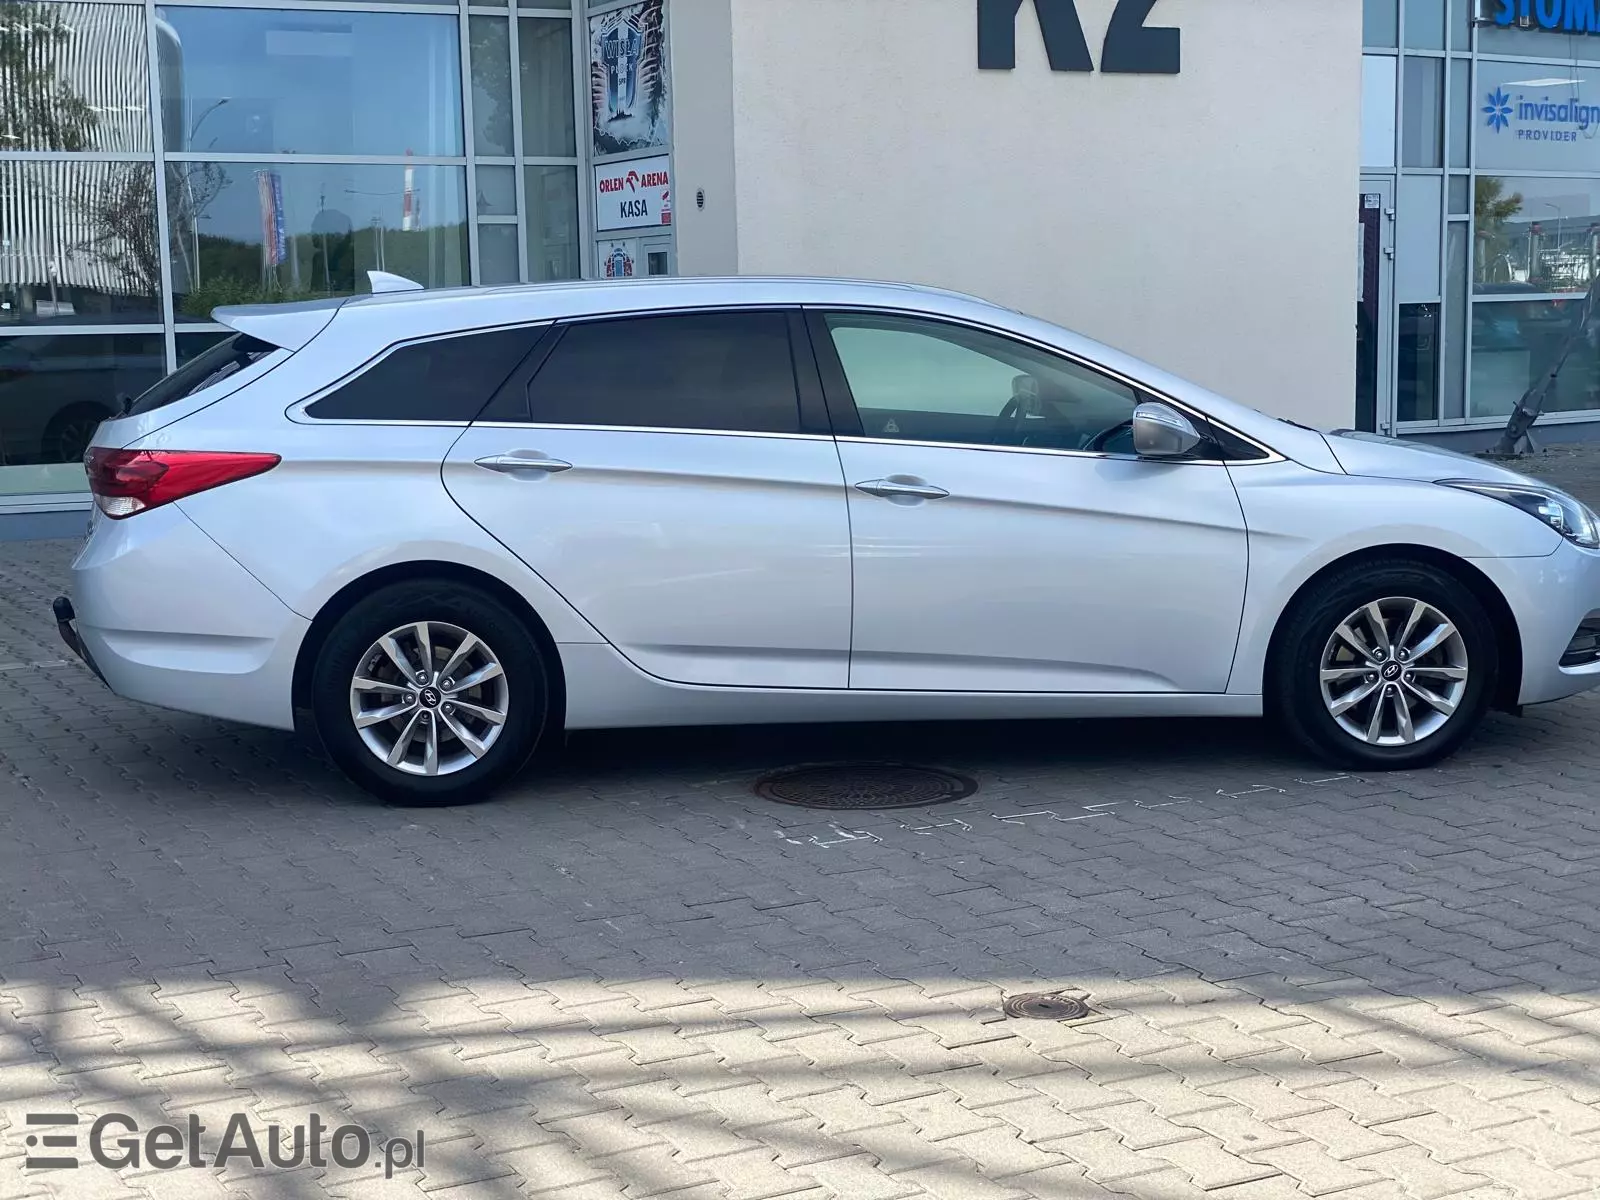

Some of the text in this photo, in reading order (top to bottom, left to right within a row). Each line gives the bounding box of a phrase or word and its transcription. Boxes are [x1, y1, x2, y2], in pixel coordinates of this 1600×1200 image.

[1516, 95, 1600, 130] invisalign
[1516, 129, 1577, 142] PROVIDER
[599, 171, 669, 193] ORLEN ARENA
[620, 199, 648, 218] KASA
